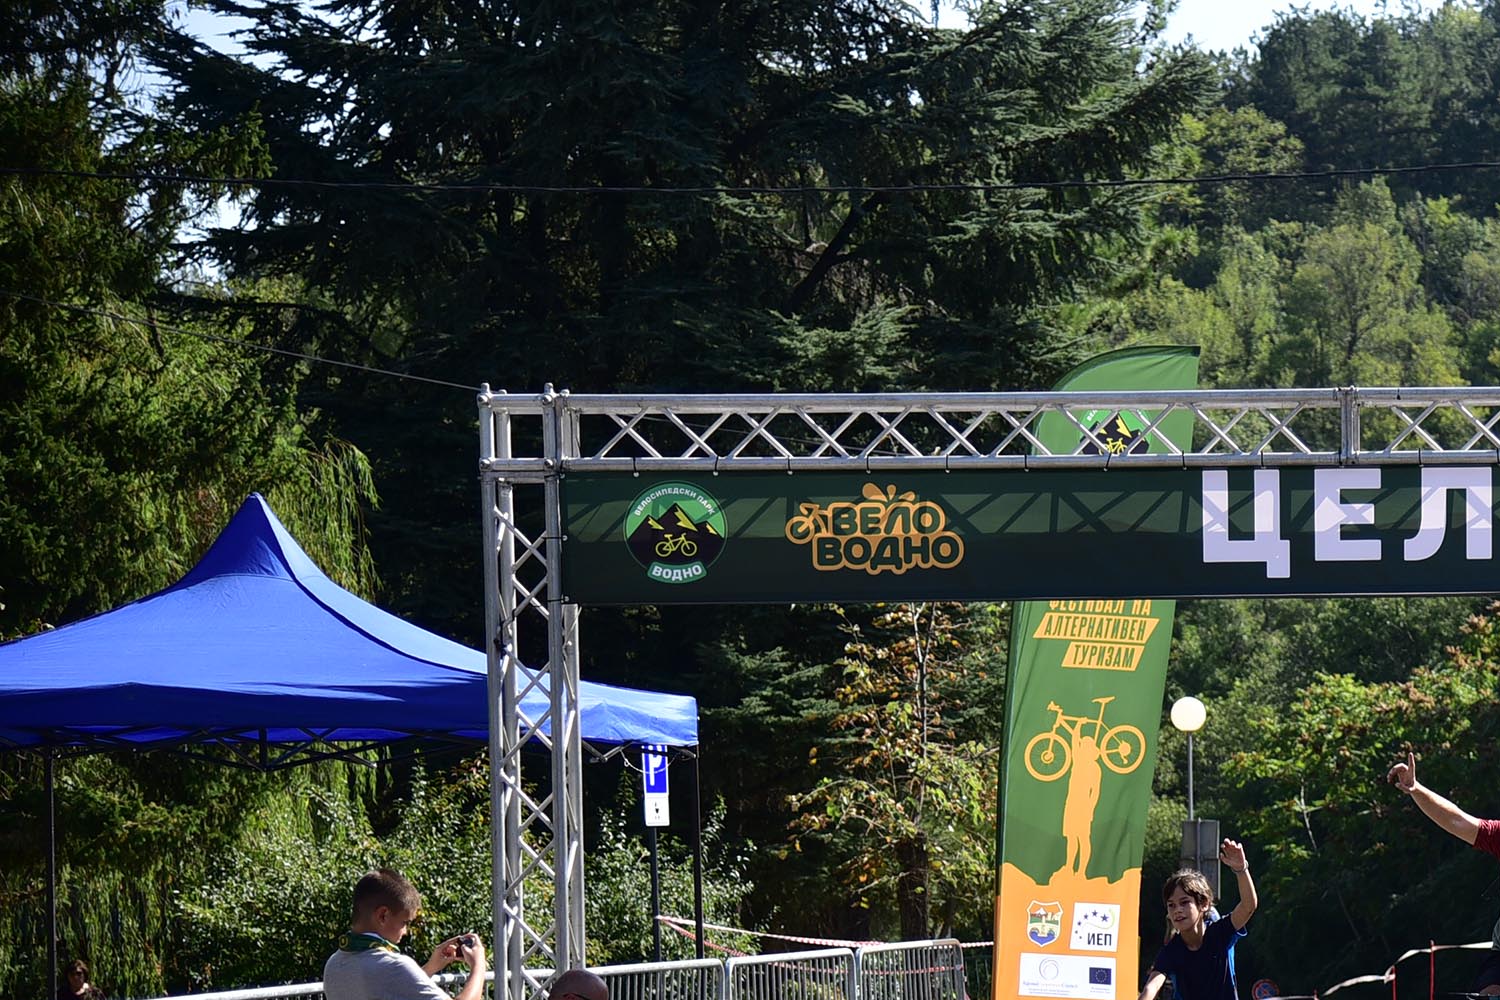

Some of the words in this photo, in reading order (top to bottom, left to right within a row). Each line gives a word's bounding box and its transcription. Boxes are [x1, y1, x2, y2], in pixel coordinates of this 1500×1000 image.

[634, 487, 697, 516] ВЕЛОСИПЕДСКИ
[696, 495, 716, 516] ПАРК
[831, 505, 942, 536] ВЕЛО
[1202, 467, 1492, 578] ЦЕЛ
[816, 535, 961, 571] ВОДНО
[651, 564, 702, 581] ВОДНО
[1044, 615, 1147, 641] АЛТЕРНАТИВЕН
[1072, 644, 1135, 668] ТУРИЗАМ
[1087, 932, 1112, 946] ИЕП
